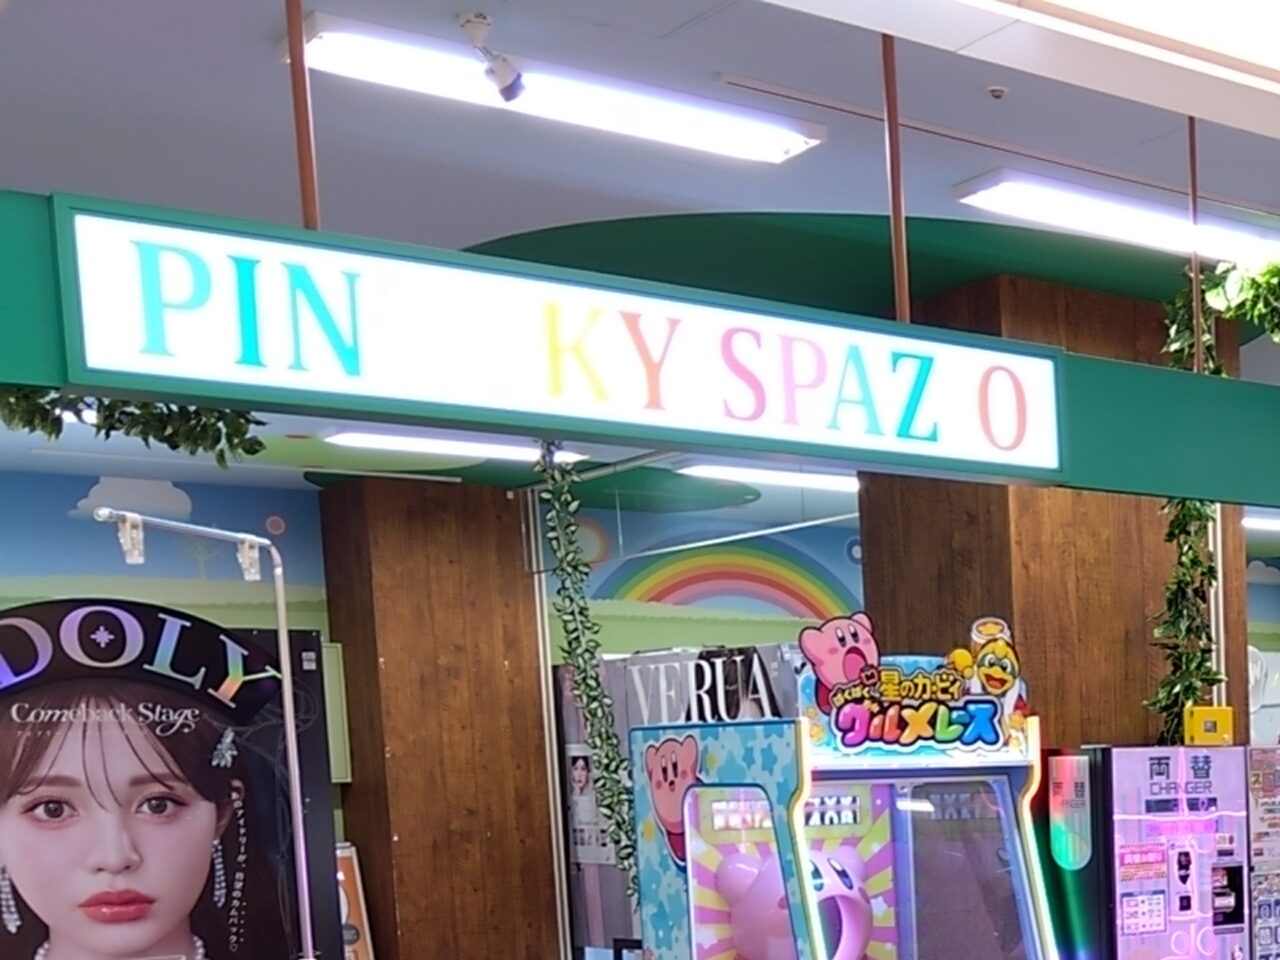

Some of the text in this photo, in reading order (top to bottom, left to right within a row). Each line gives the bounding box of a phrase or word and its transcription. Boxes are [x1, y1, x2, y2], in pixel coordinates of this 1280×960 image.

[130, 240, 1028, 451] PIN KY SPAZ O
[628, 652, 780, 727] VERUA
[11, 702, 200, 737] Comeback Stage
[838, 700, 1000, 747] グルメレース
[1148, 755, 1212, 780] 両替
